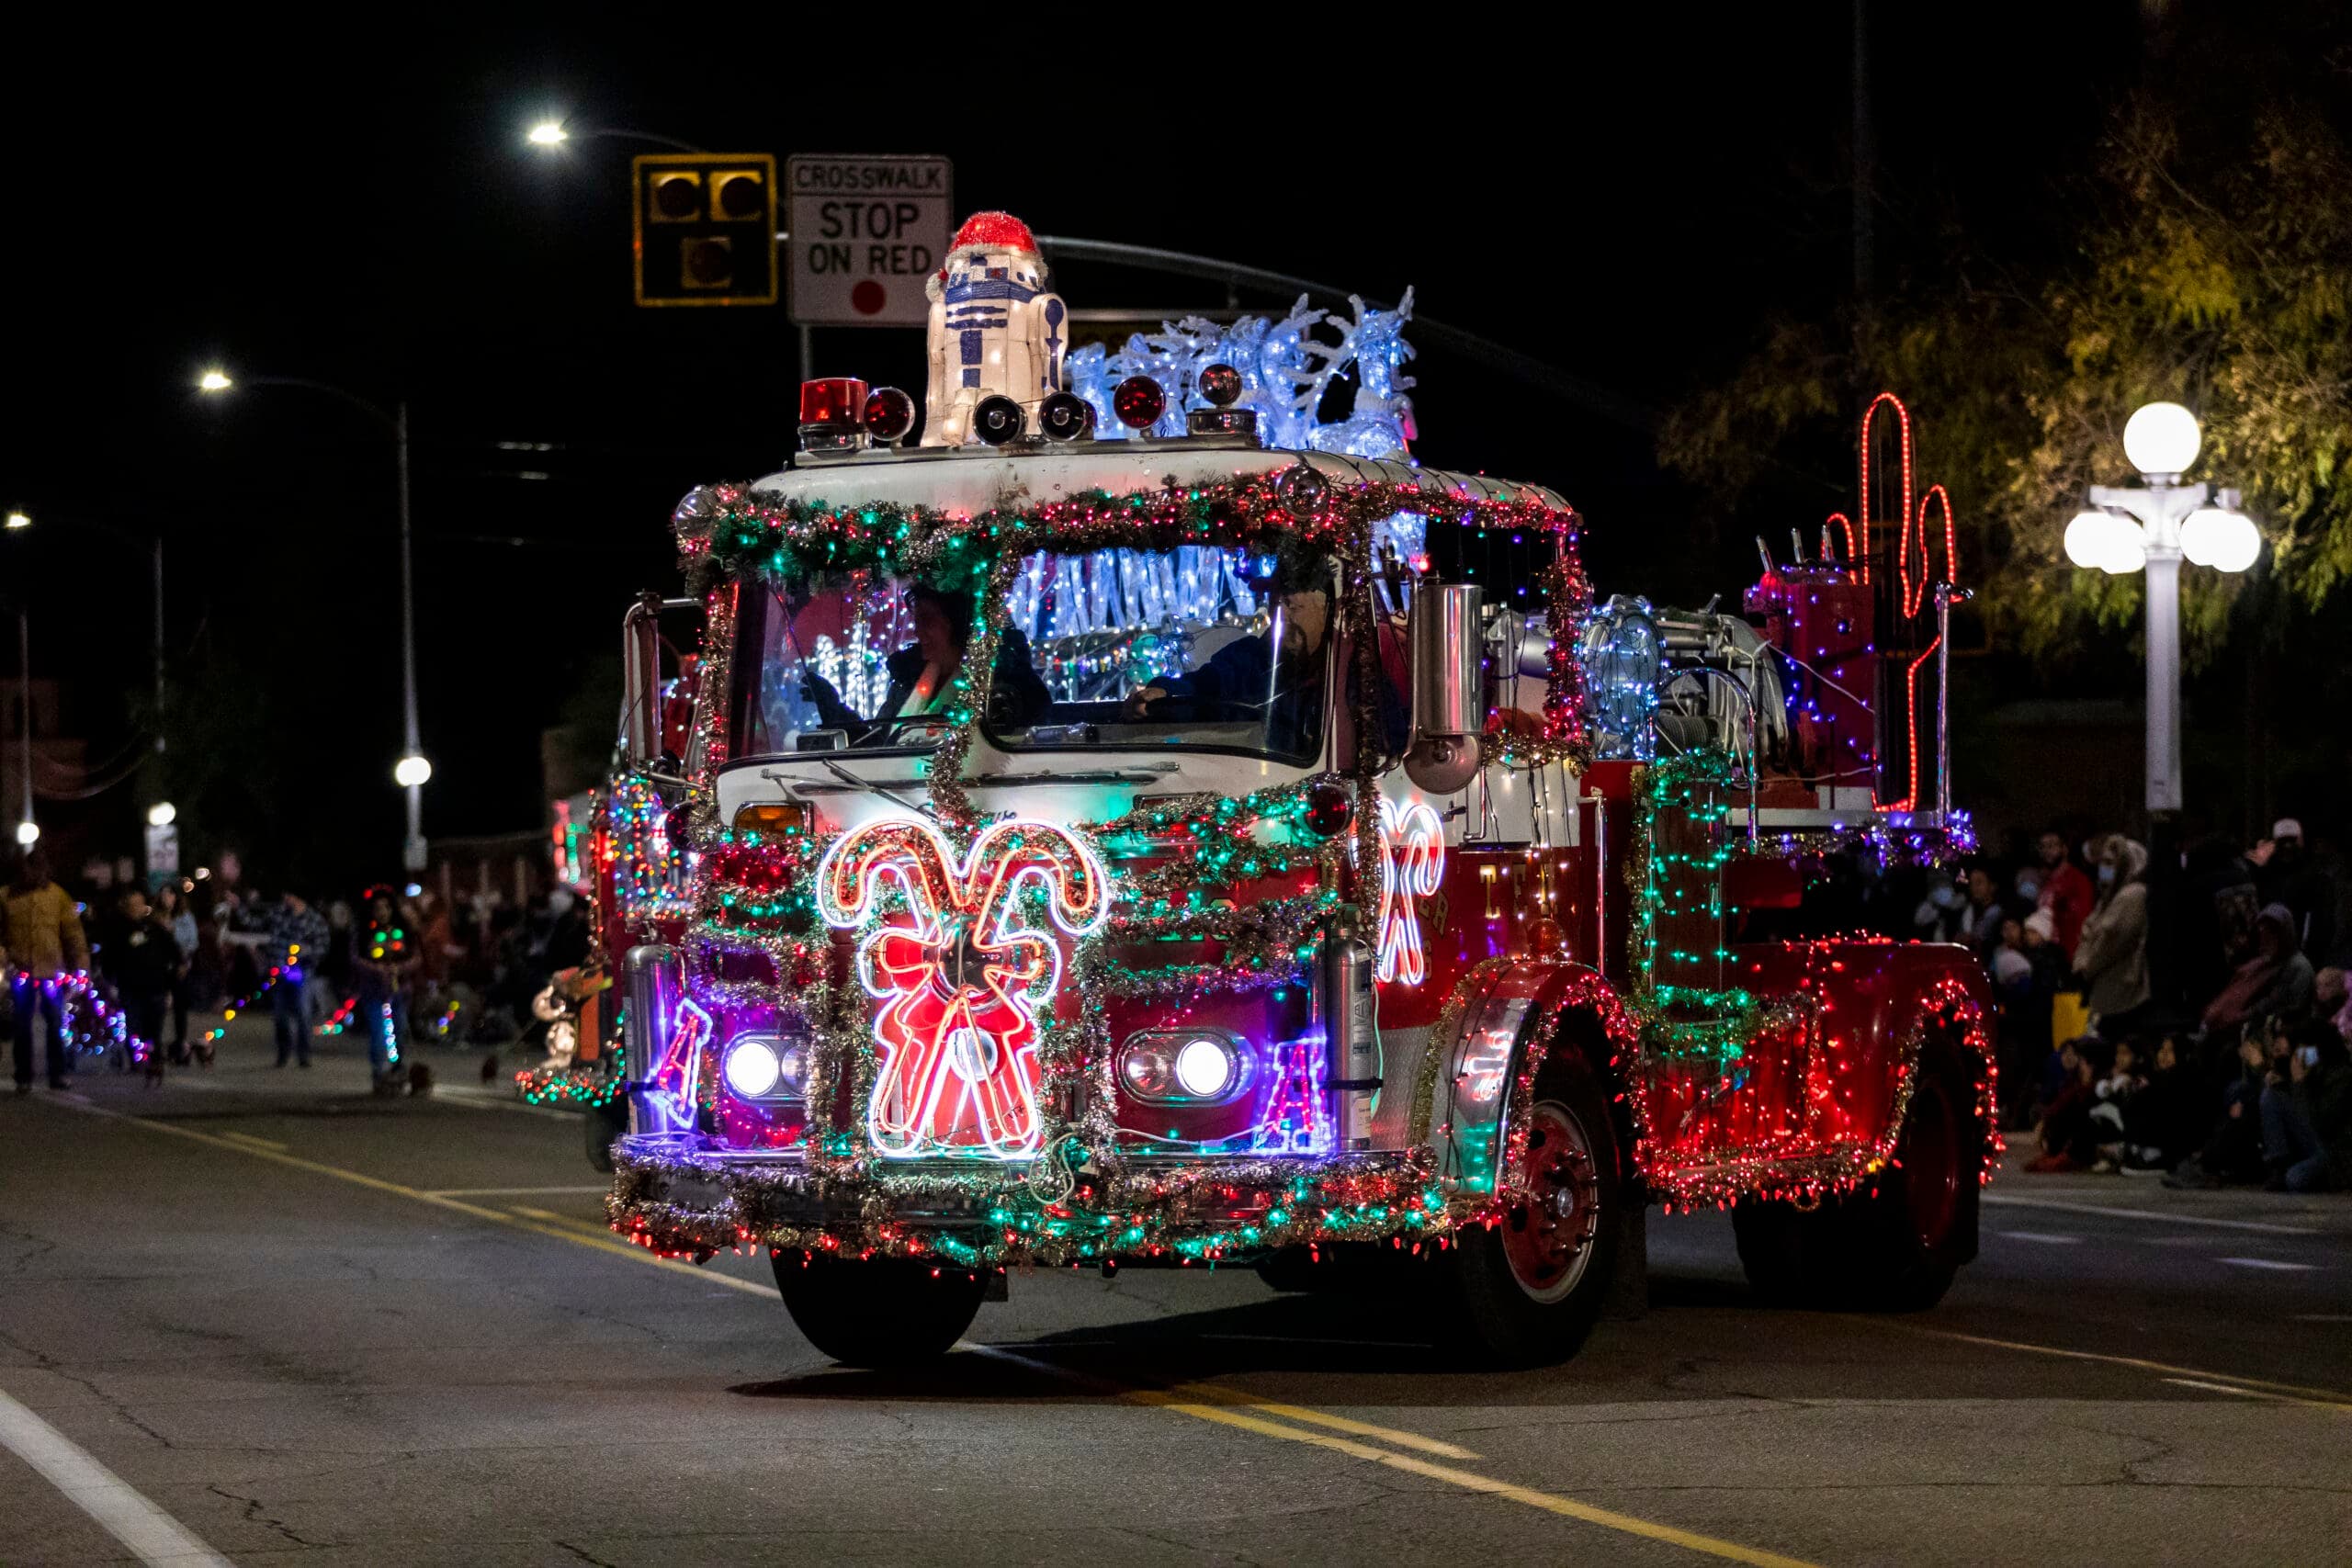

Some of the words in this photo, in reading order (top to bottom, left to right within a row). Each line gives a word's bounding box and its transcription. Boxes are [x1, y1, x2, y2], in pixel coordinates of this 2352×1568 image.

[795, 164, 944, 189] CROSSWALK
[820, 201, 919, 239] STOP
[808, 243, 851, 274] ON
[868, 244, 933, 275] RED
